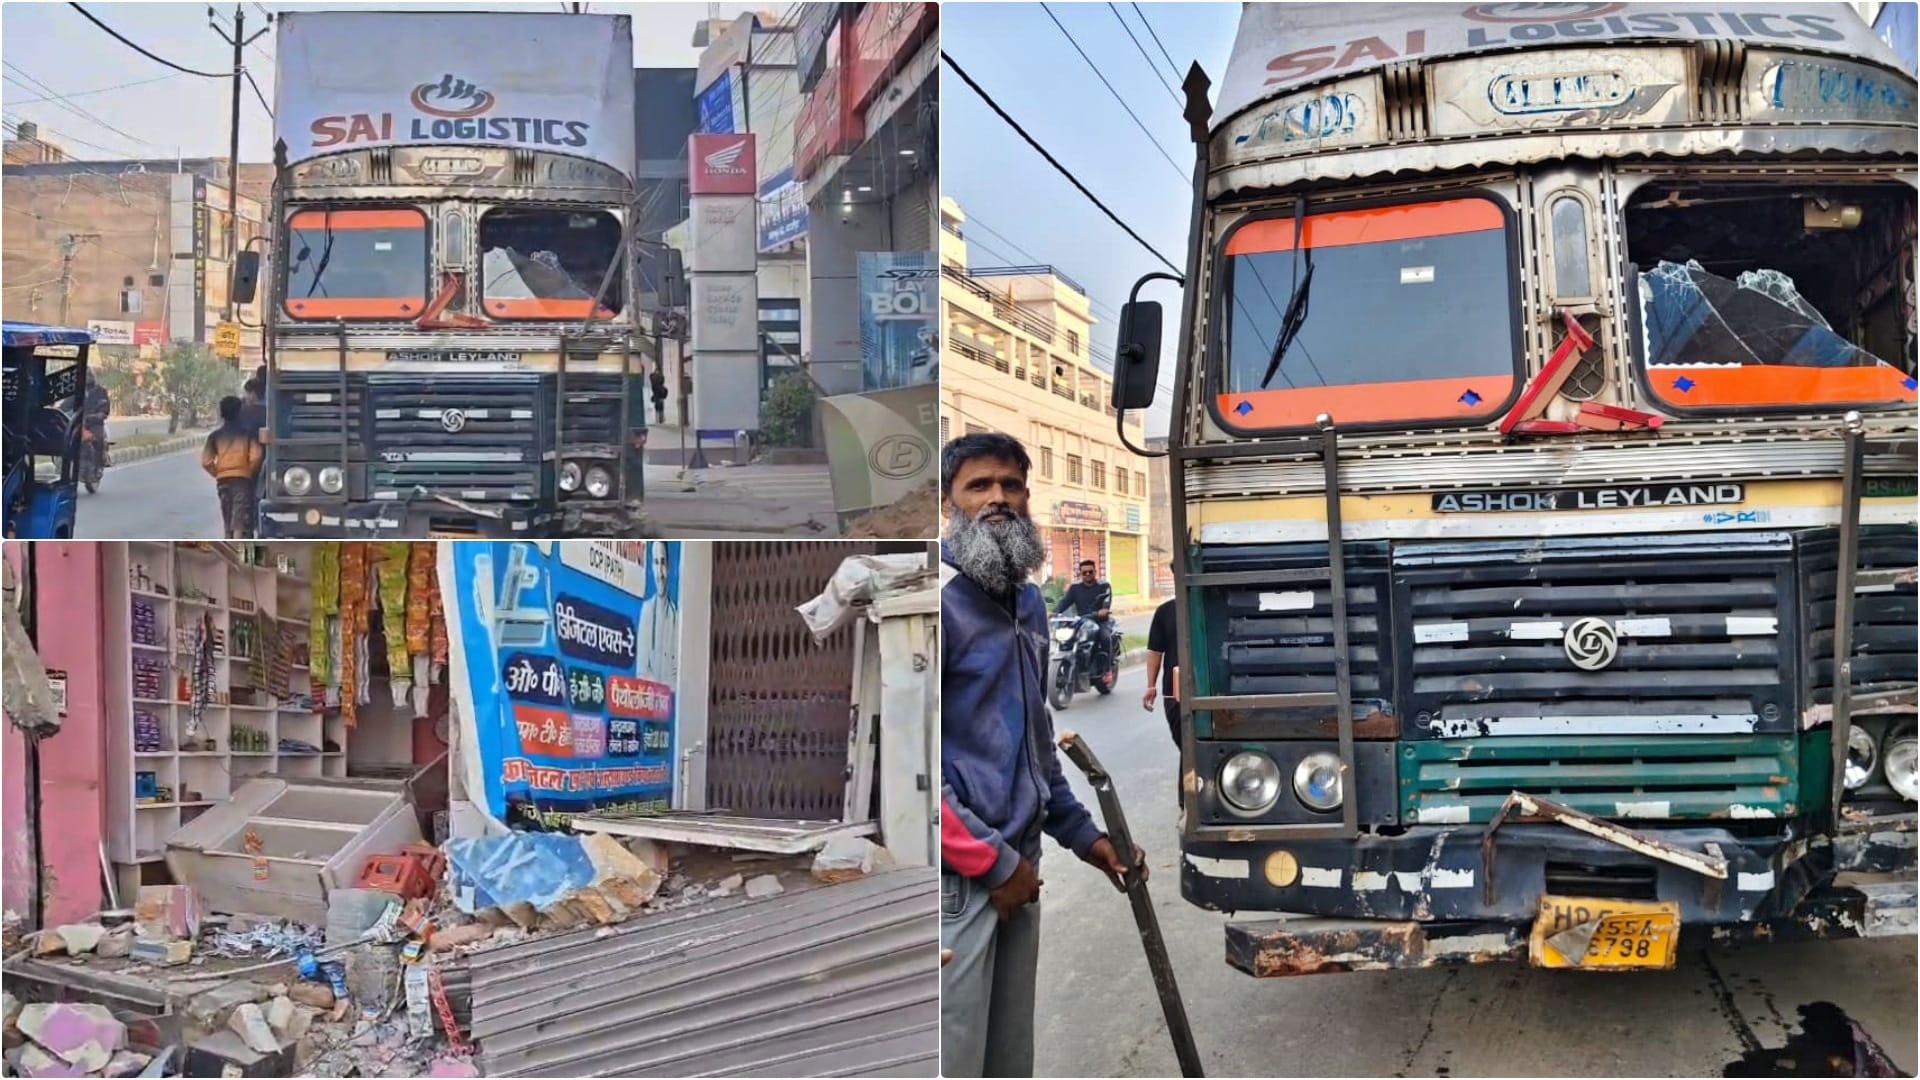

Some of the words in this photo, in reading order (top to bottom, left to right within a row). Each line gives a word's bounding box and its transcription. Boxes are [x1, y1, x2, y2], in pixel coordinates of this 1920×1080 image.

[1264, 29, 1426, 85] SAI
[1468, 11, 1846, 47] LOGISTICS
[310, 112, 392, 147] SAI
[411, 117, 590, 147] LOGISTICS
[449, 353, 520, 361] LEYLAND
[1437, 494, 1556, 512] ASHOK
[1578, 485, 1741, 509] LEYLAND
